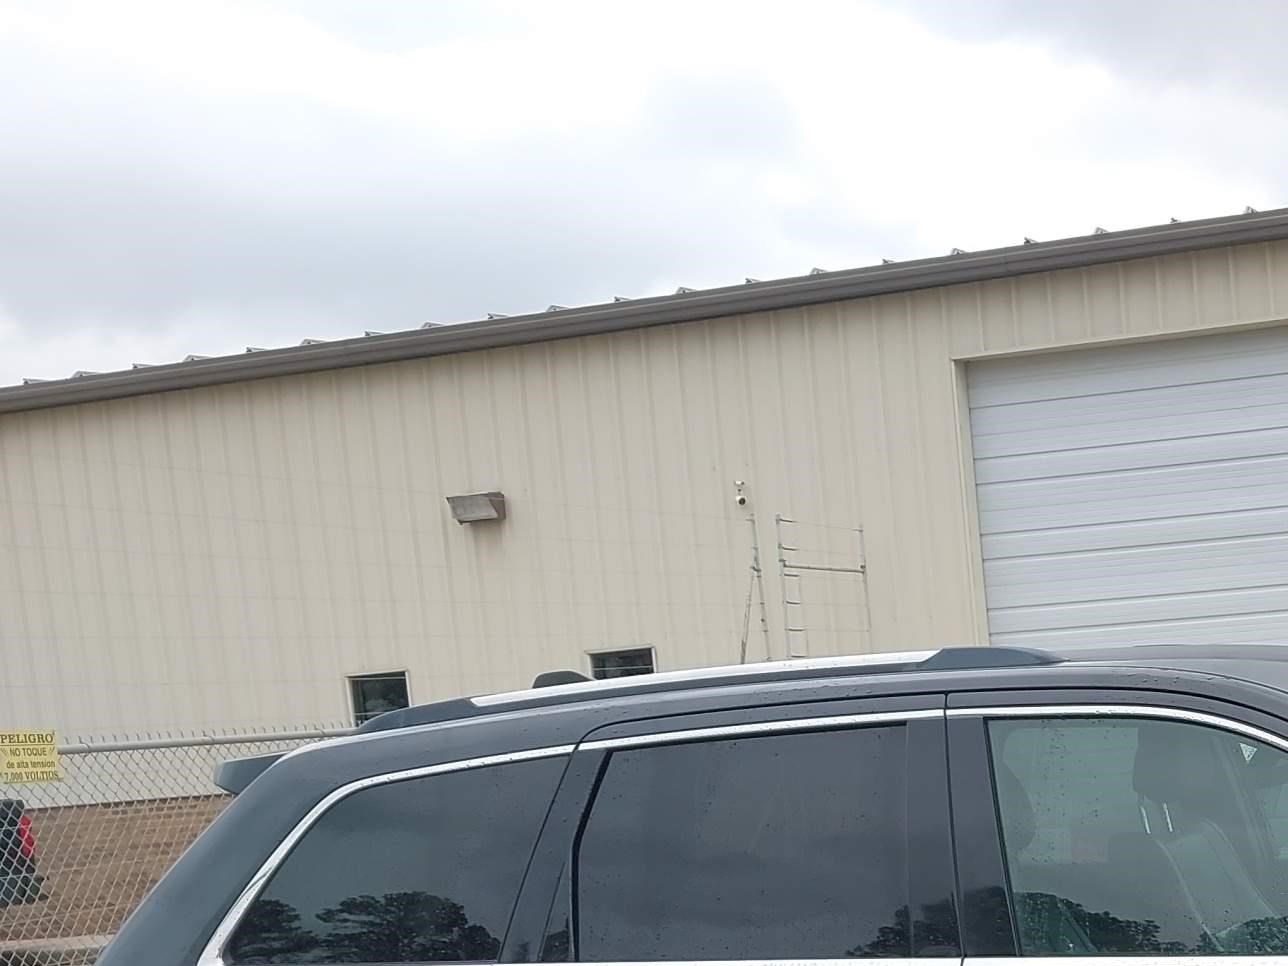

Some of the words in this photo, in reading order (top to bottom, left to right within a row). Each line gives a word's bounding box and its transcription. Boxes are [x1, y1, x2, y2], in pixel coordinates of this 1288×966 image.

[0, 733, 53, 743] PELIGRO
[10, 748, 20, 756] NO
[22, 747, 47, 757] TOQUE
[24, 771, 58, 780] VOLTIOS
